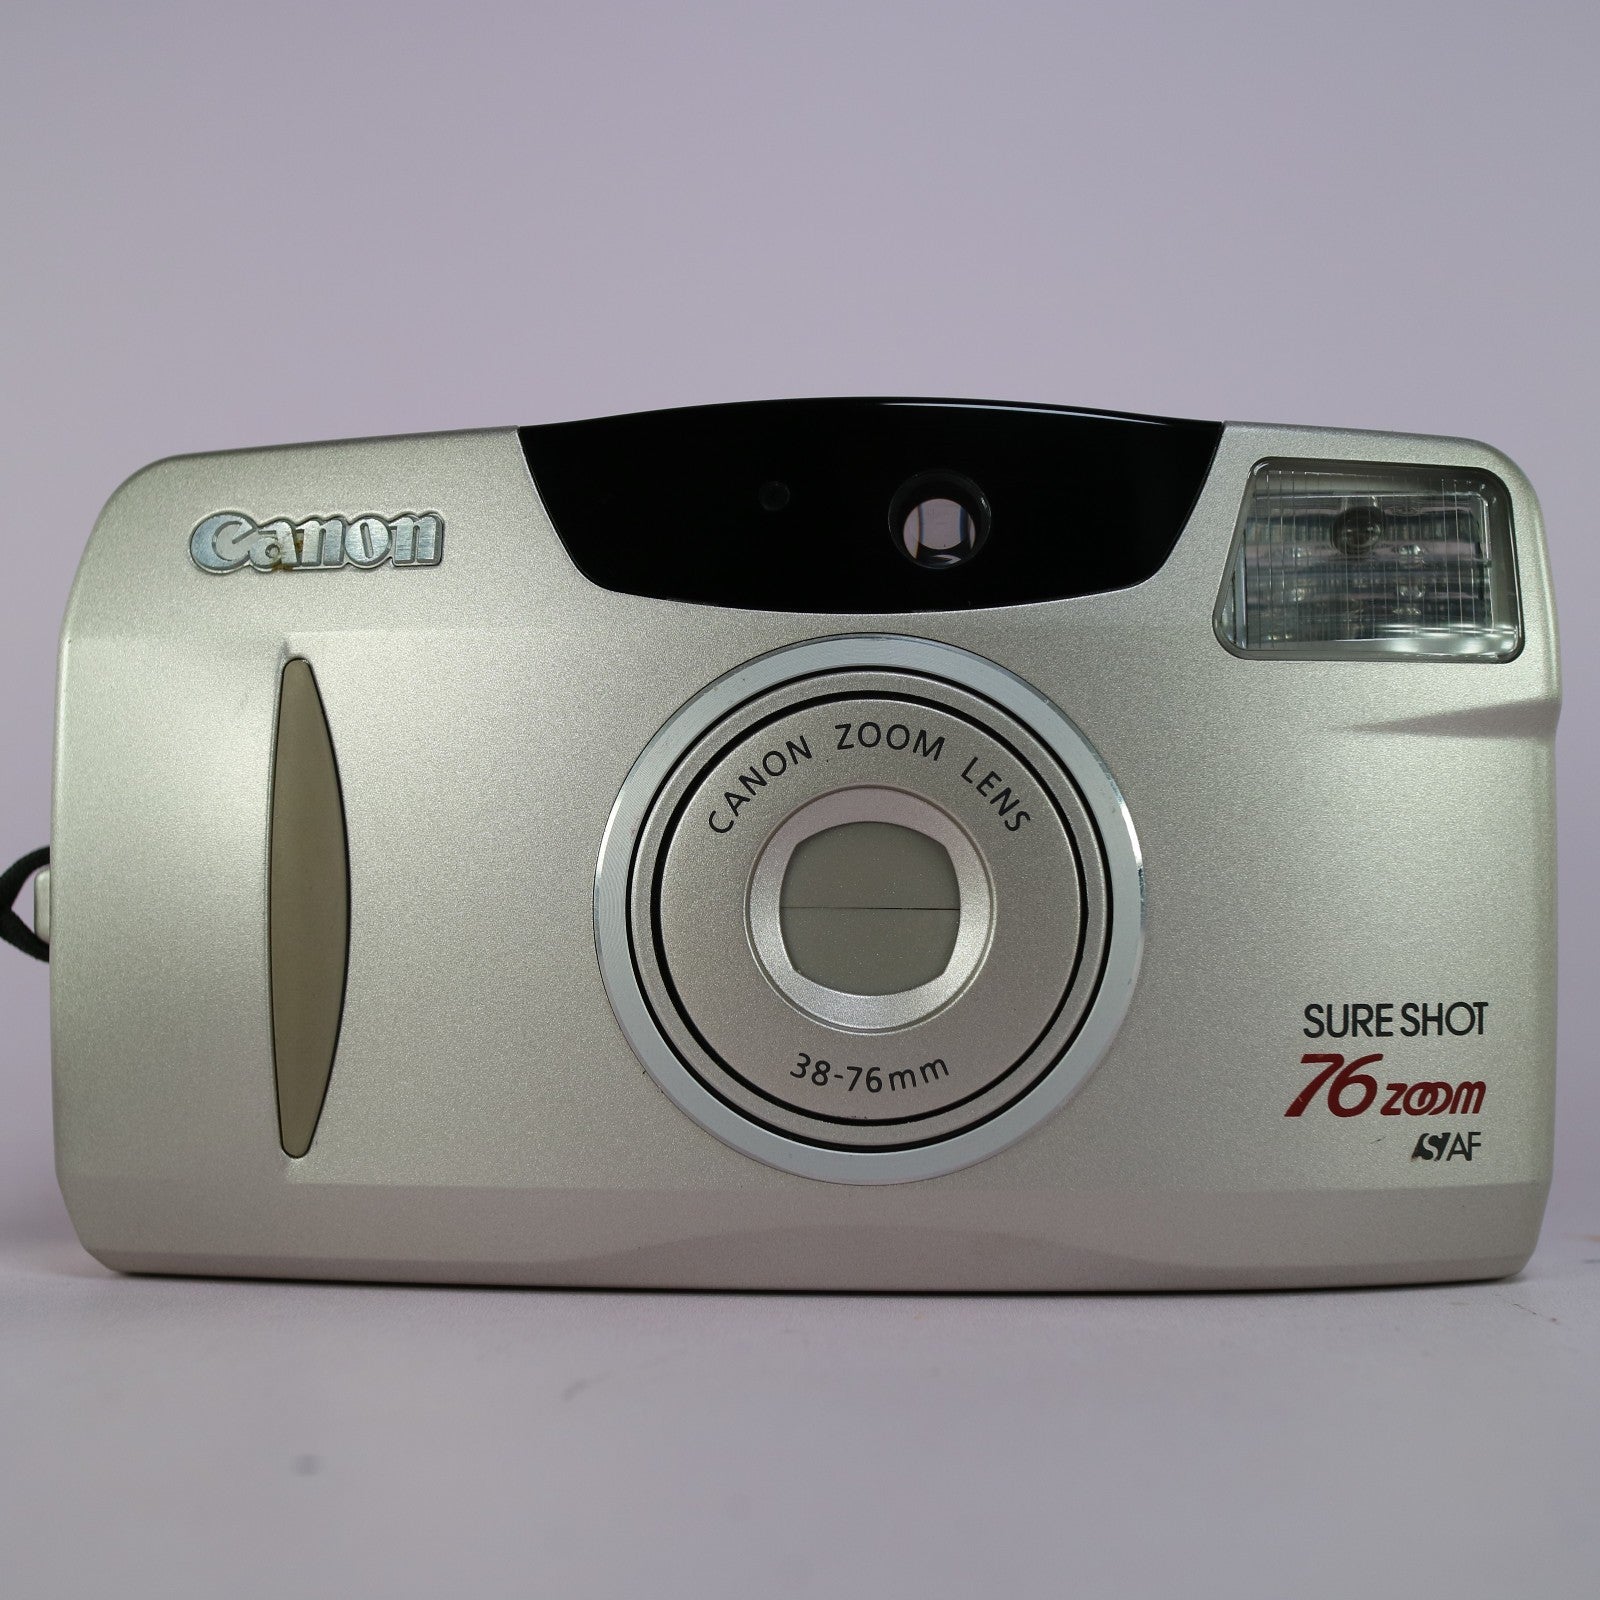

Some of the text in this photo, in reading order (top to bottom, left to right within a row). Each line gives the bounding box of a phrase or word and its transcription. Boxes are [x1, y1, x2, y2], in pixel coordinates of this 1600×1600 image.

[190, 511, 444, 574] Canon
[708, 721, 1031, 834] CANON ZOOM LENS
[1303, 1001, 1489, 1038] SURE SHOT
[789, 1052, 950, 1093] 38-76mm
[1284, 1053, 1384, 1117] 76
